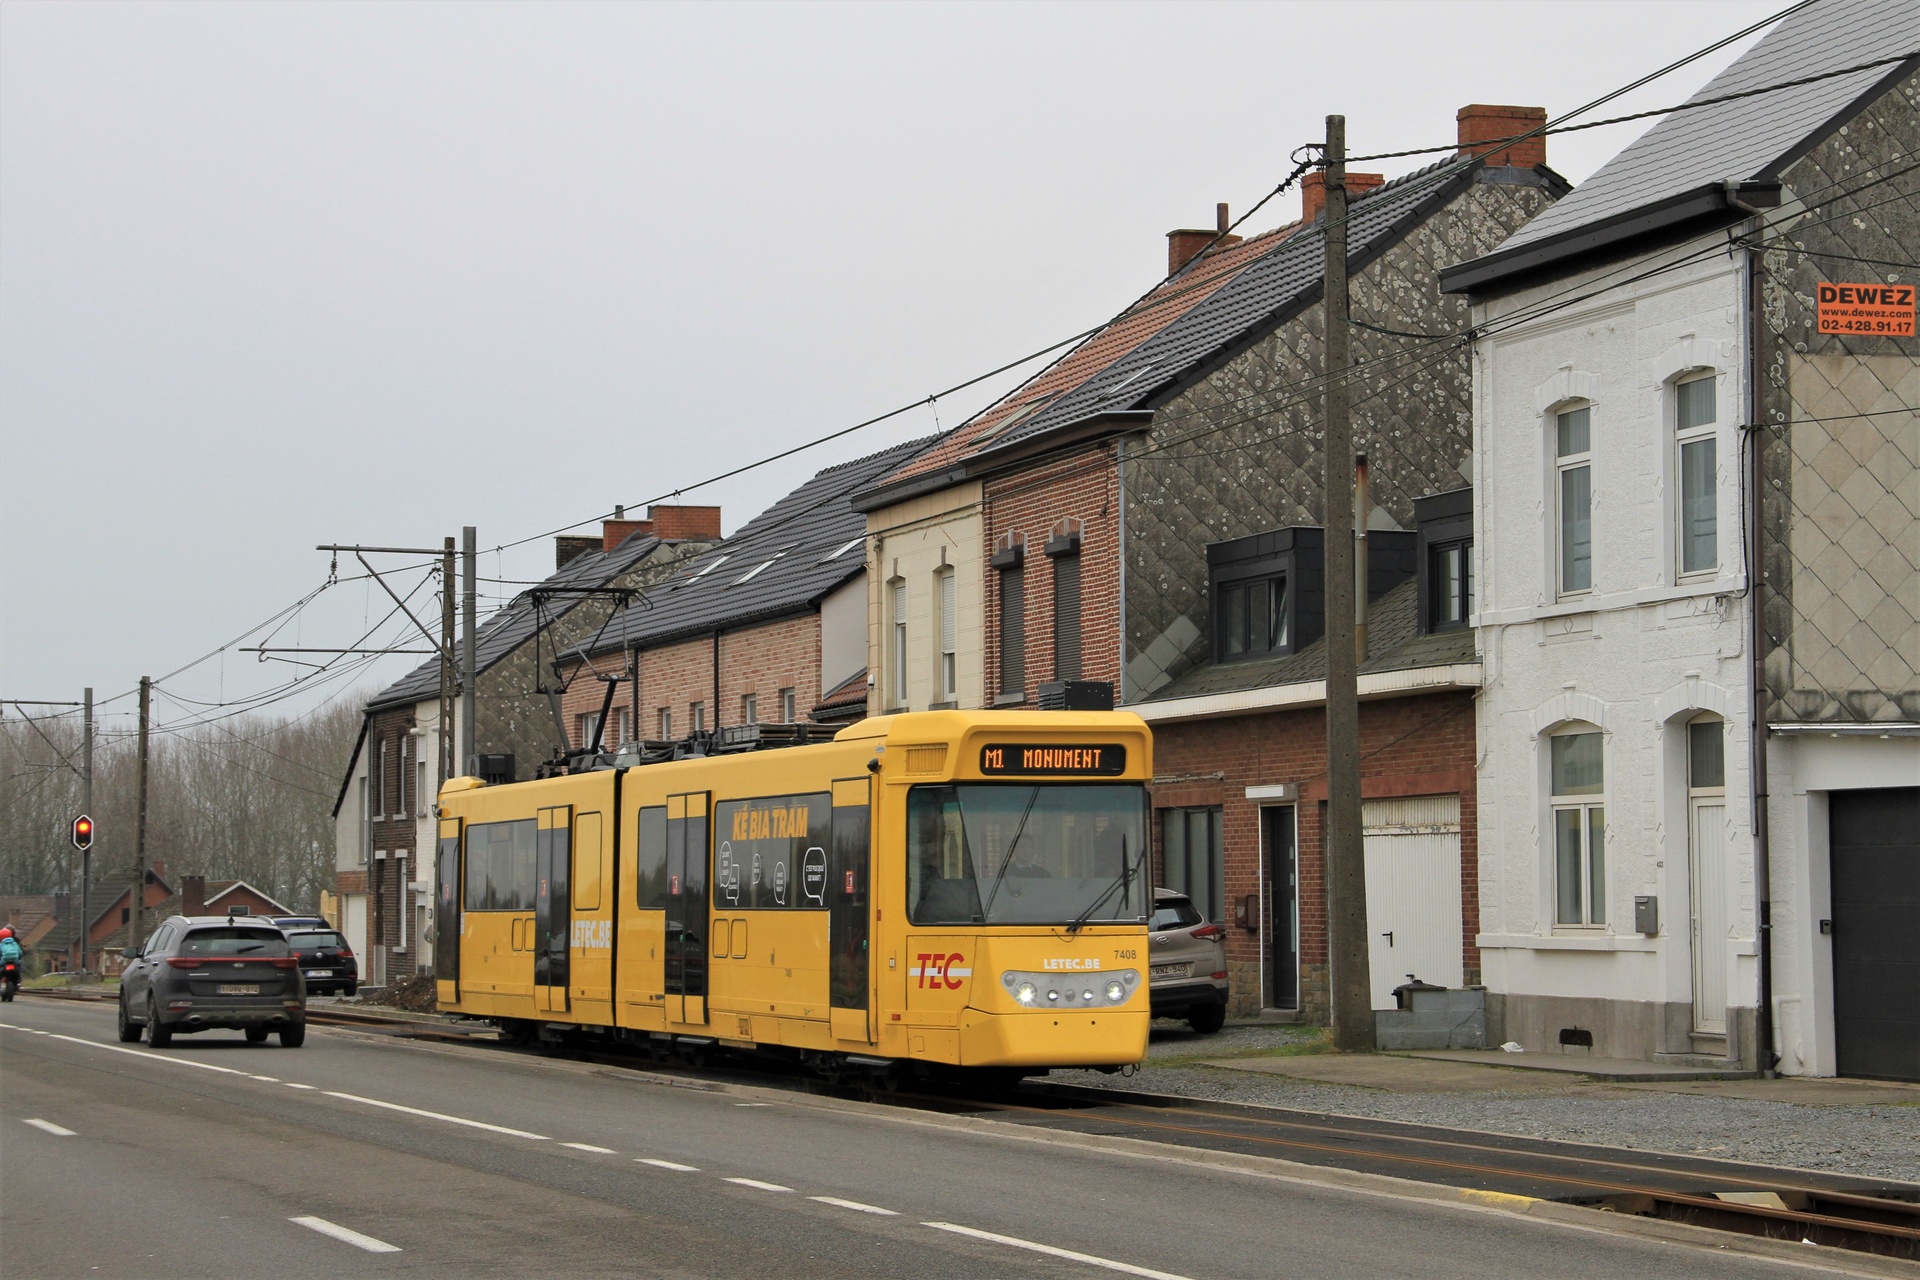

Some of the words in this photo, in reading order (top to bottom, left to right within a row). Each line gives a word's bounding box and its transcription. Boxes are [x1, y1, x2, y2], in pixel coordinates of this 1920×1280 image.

[1820, 286, 1912, 305] DEWEZ
[1821, 308, 1912, 318] www.dewez.com
[1821, 320, 1912, 332] 02-428.91.17
[985, 749, 1004, 768] M1
[1023, 749, 1101, 768] MONUMENT
[772, 804, 808, 838] TRAM
[570, 920, 611, 948] LETEC.BE
[1044, 958, 1100, 970] LETEC.BE
[1114, 950, 1137, 960] 7408
[917, 952, 965, 990] TEC
